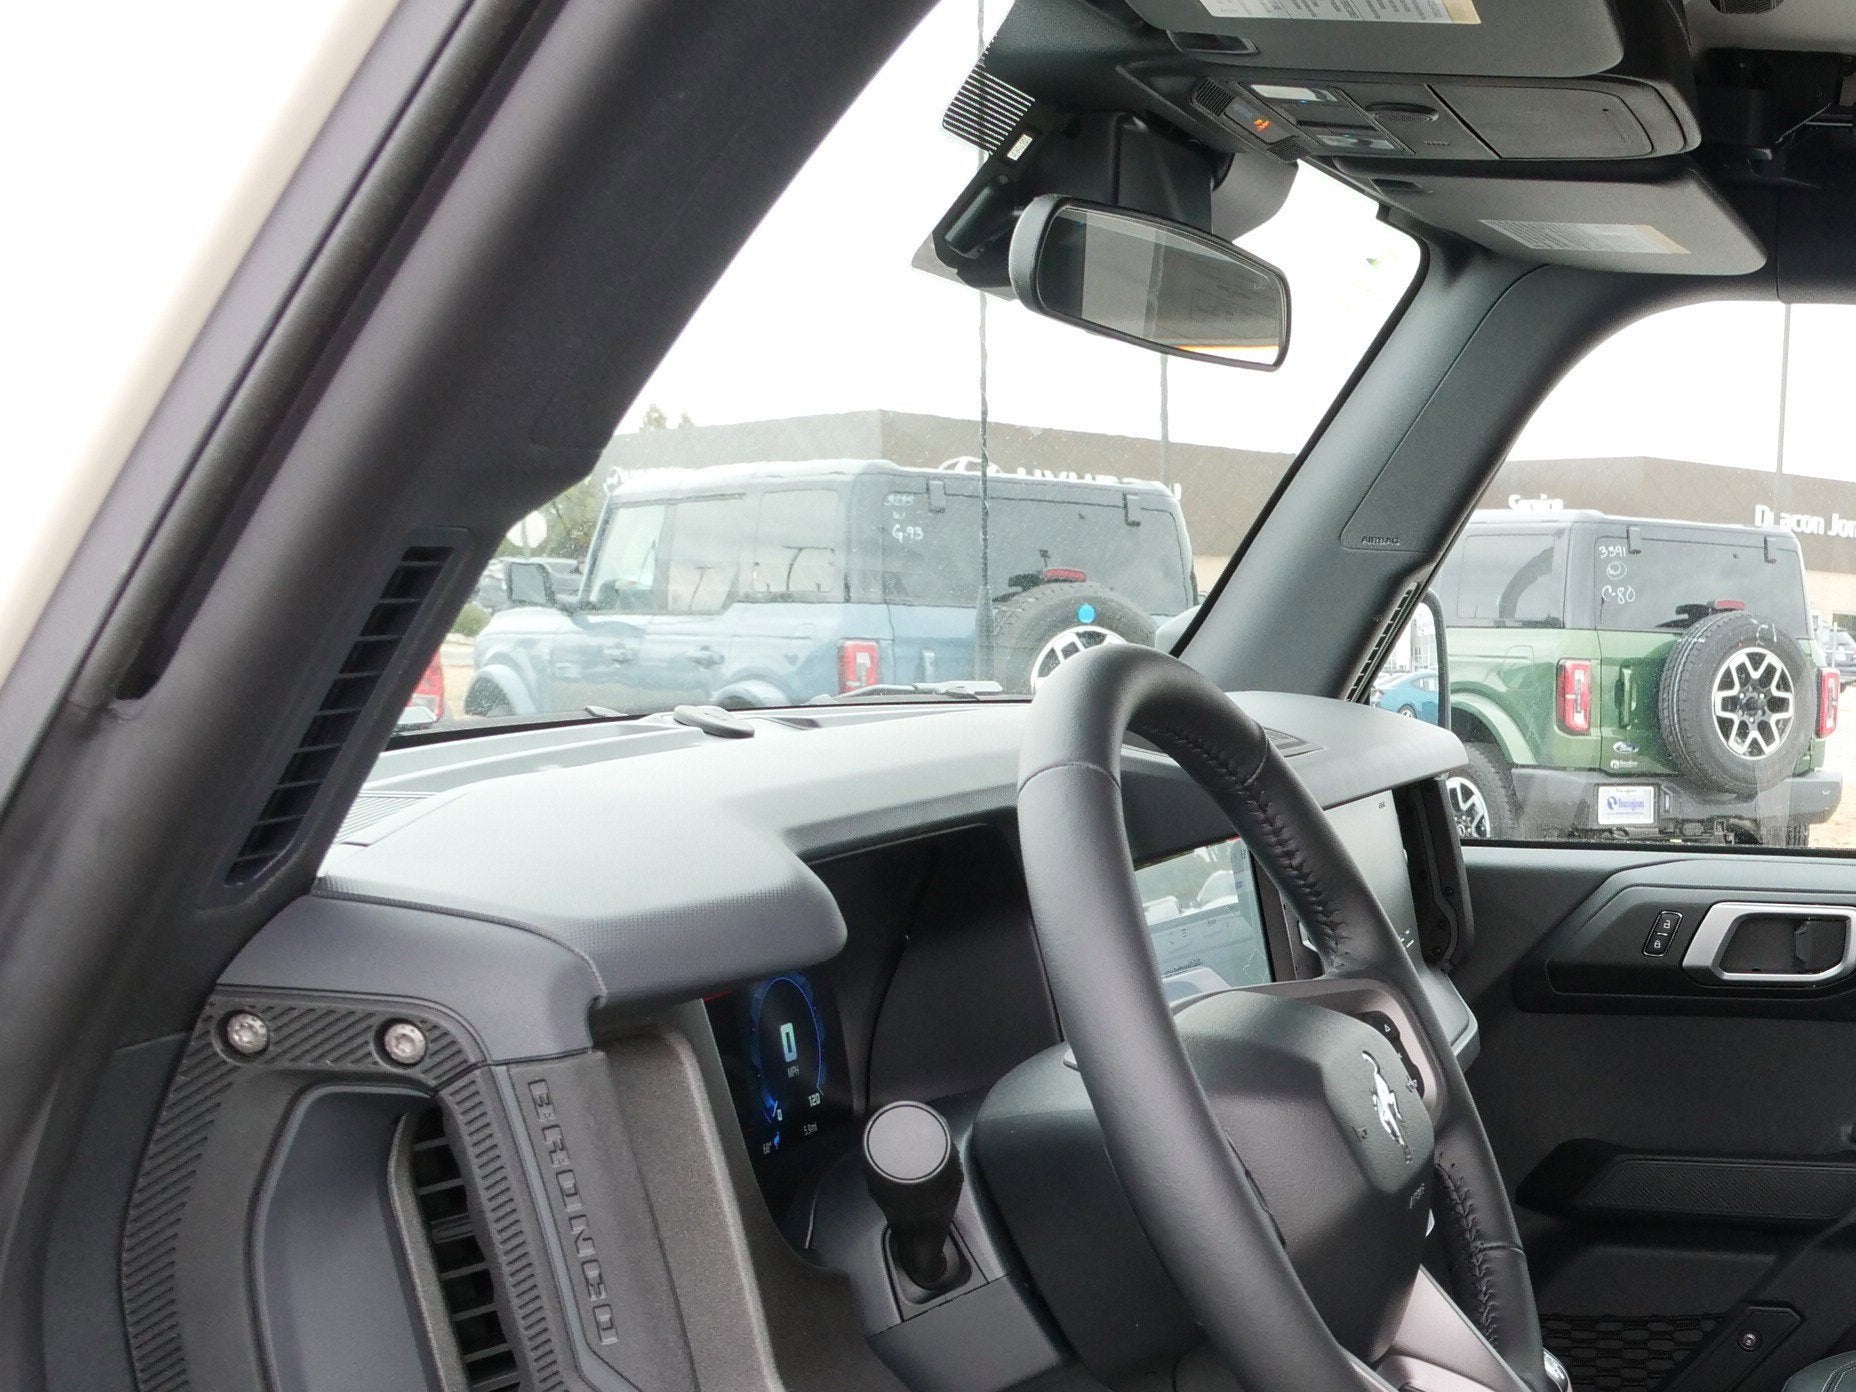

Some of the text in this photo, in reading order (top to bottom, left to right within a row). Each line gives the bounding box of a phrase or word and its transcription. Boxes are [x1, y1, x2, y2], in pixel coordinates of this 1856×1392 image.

[780, 1022, 798, 1063] 0
[808, 1092, 821, 1108] 120
[527, 1078, 620, 1346] BRONCO
